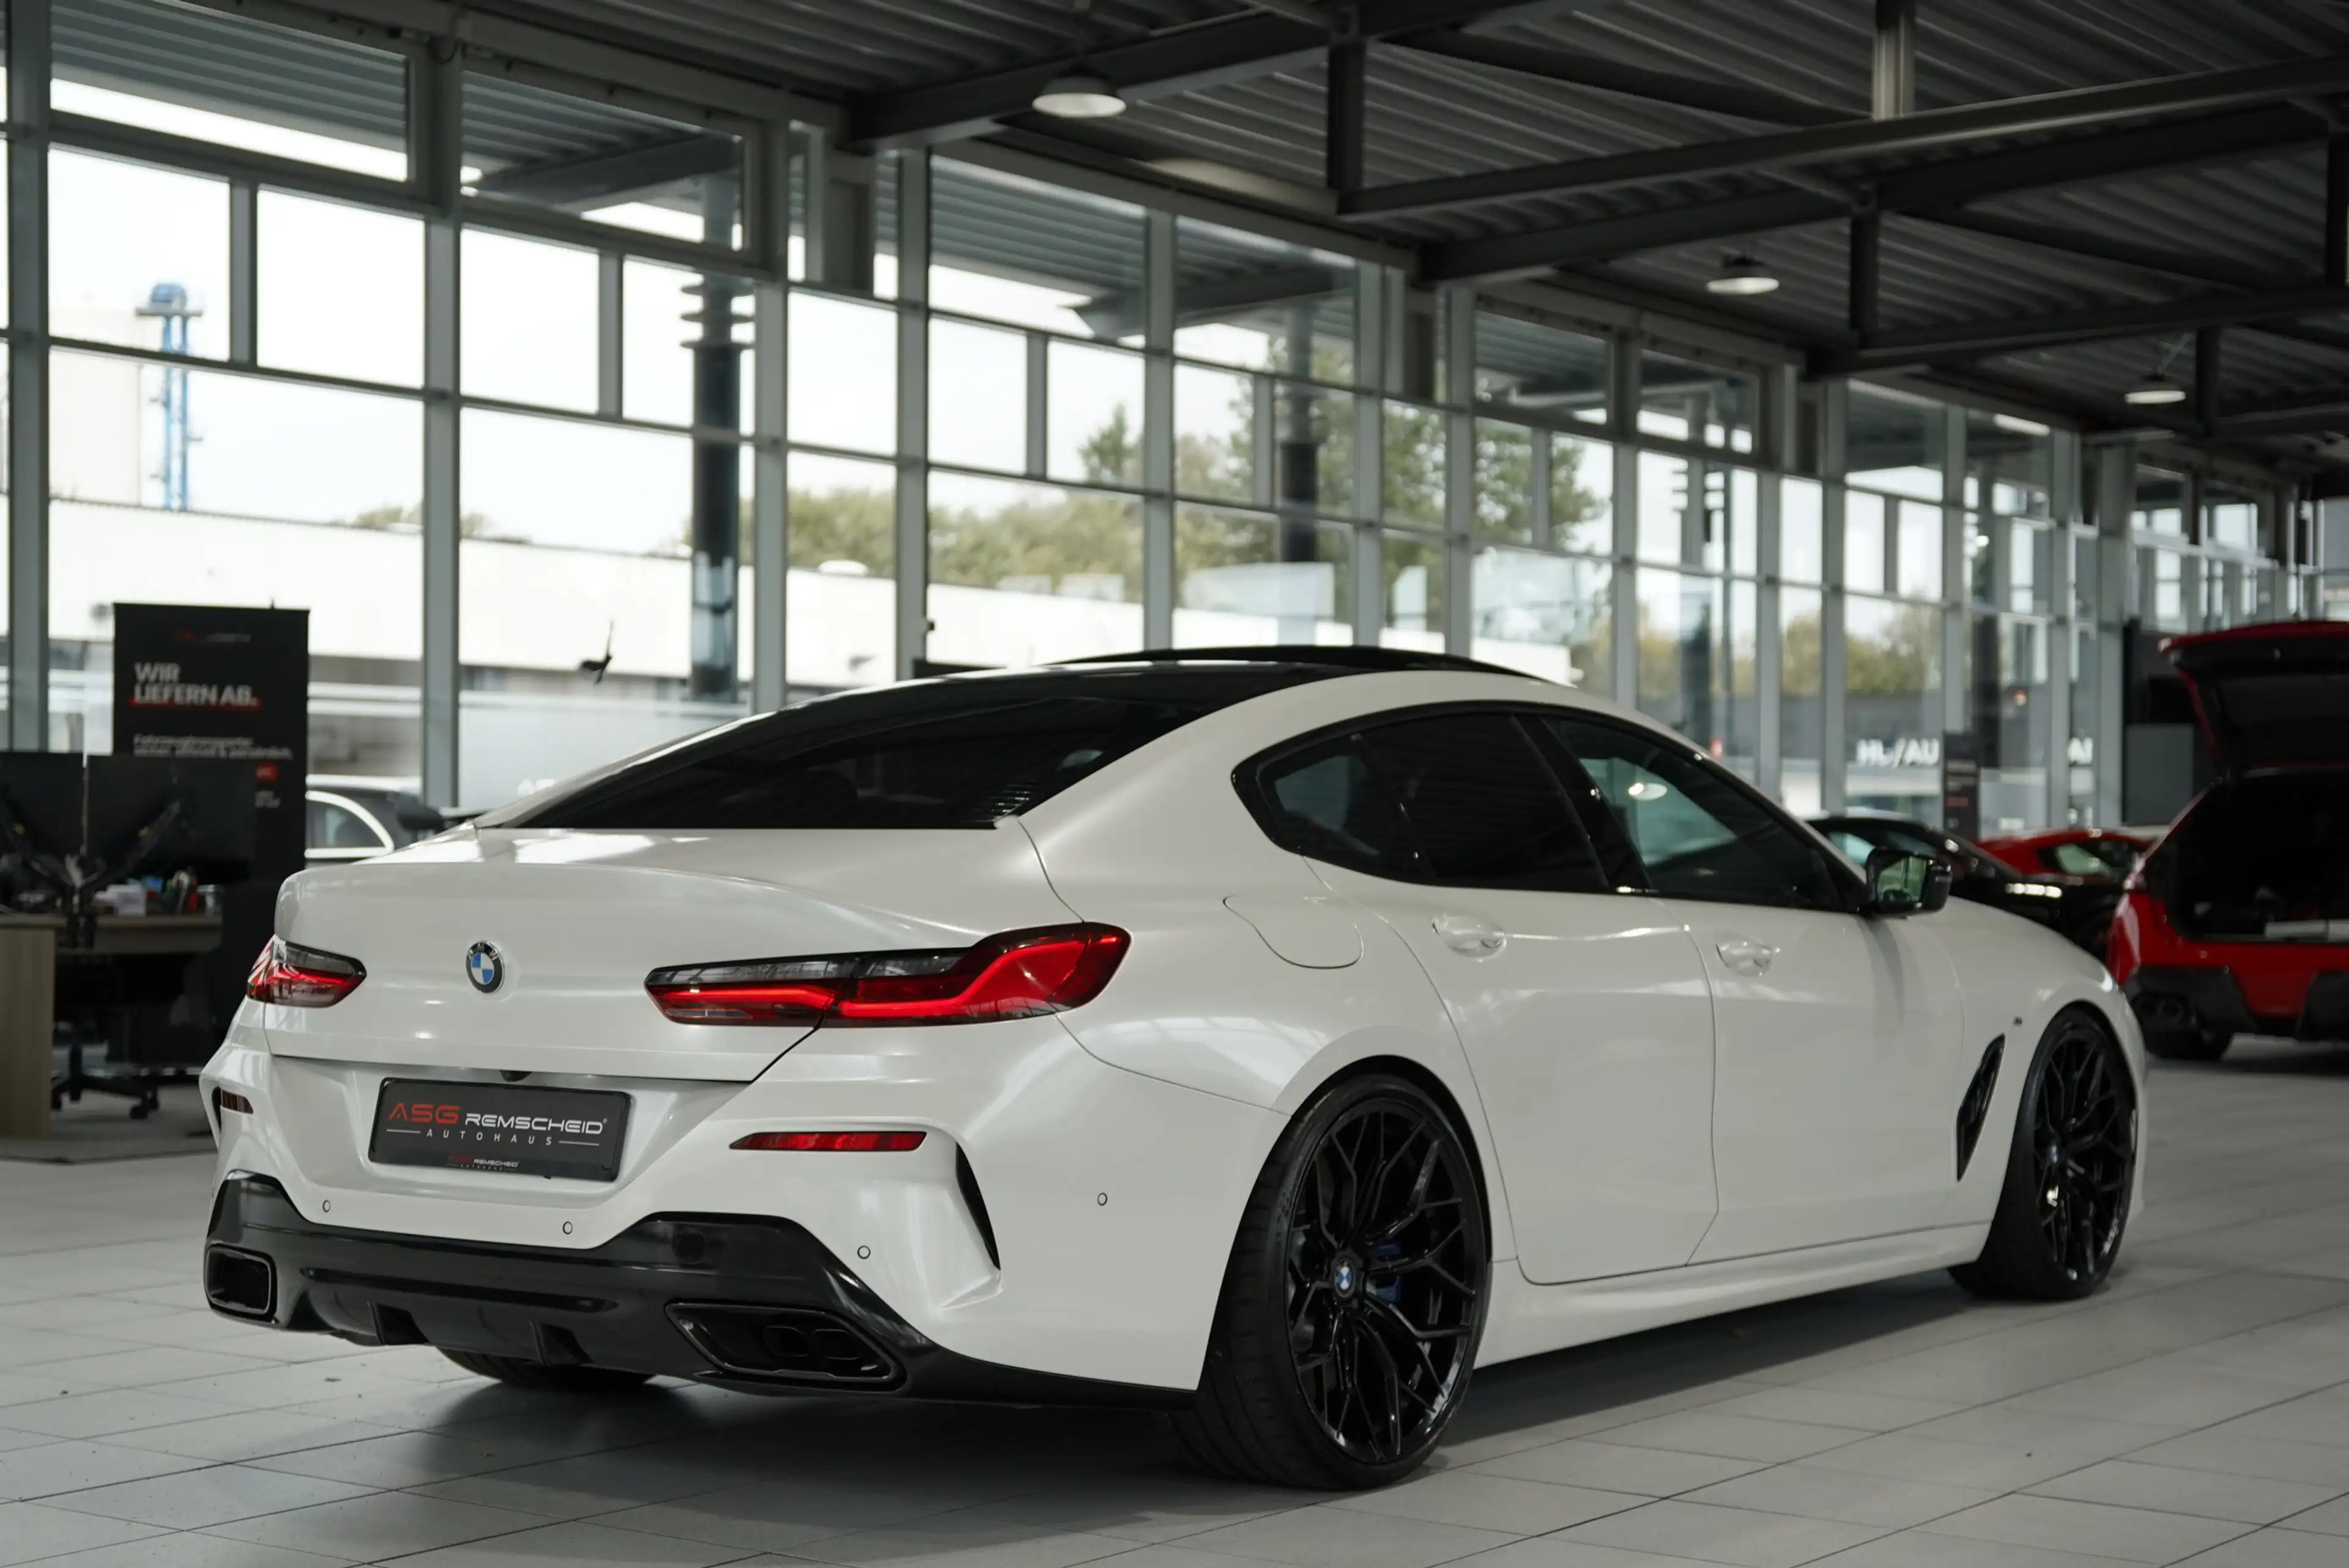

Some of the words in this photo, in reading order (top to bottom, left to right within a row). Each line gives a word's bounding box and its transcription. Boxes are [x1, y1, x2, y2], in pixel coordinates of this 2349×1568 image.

[134, 662, 180, 683] WIR
[134, 683, 218, 706] LIEFERN
[467, 943, 499, 961] BMW
[389, 1102, 460, 1124] ASG
[465, 1113, 603, 1135] REMSCHEID
[426, 1129, 552, 1146] AUTOHAUS
